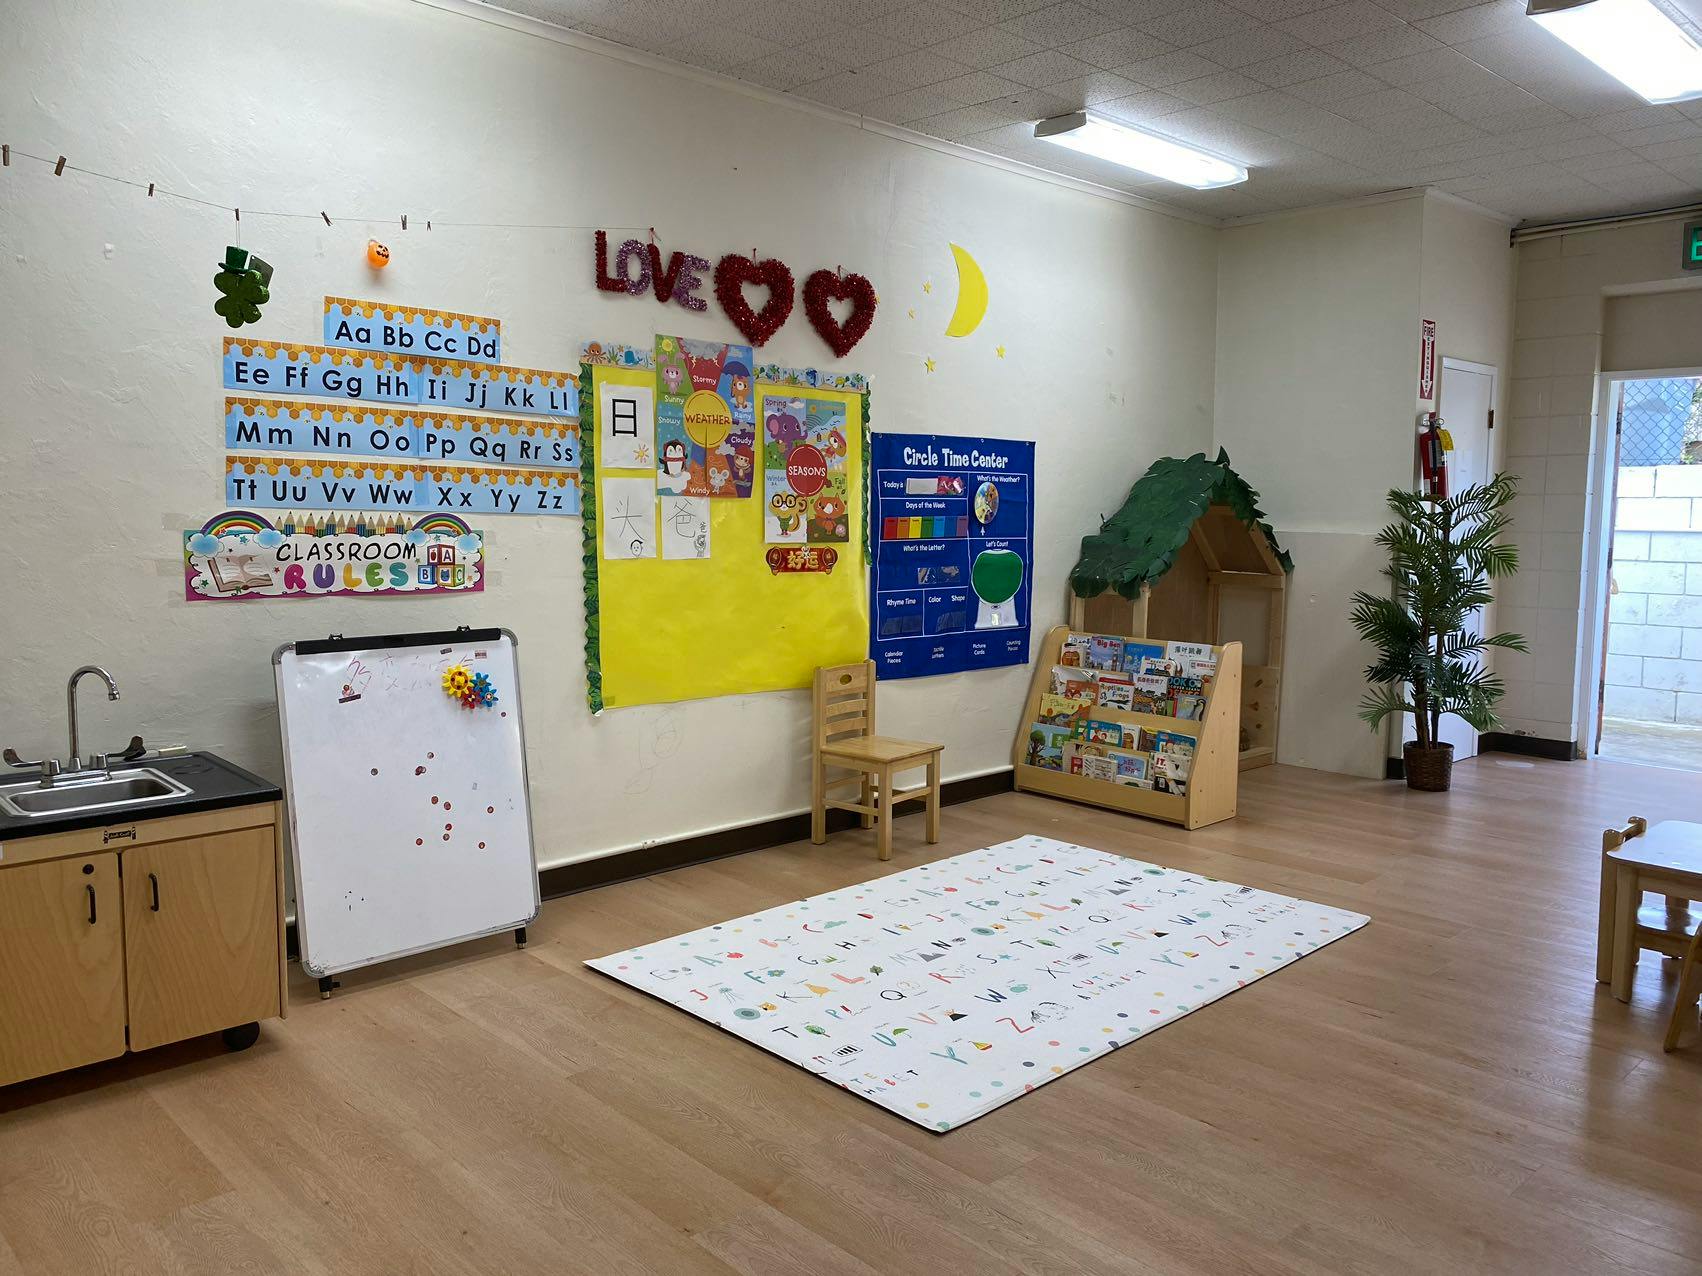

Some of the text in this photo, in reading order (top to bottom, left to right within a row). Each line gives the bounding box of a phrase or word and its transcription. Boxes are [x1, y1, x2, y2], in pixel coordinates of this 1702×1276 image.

[595, 230, 711, 311] LOVE
[1424, 325, 1434, 337] FIRE
[335, 321, 496, 359] Aa Bb Cc Dd
[235, 362, 568, 410] Ee Ff Gg Hh Ii Jj Kk Ll
[693, 375, 717, 386] Stormy
[665, 395, 684, 404] Sunny
[765, 398, 787, 409] Spring
[658, 417, 680, 425] Snowy
[685, 413, 731, 425] WEATHER
[734, 412, 752, 421] Rainy
[236, 421, 573, 462] Mm Nn Oo Pp Qq Rr Ss
[731, 436, 752, 446] Cloudy
[903, 446, 1008, 469] Circle Time Center
[788, 466, 826, 477] SEASONS
[766, 475, 787, 483] Winter
[835, 477, 845, 485] Fall
[884, 481, 899, 490] Today
[232, 479, 562, 512] Tt Uu Vv Ww Xx Yy Zz
[690, 487, 711, 496] Windy
[905, 501, 917, 509] Days
[611, 496, 644, 540] 头
[276, 543, 416, 561] CLASSROOM
[443, 551, 452, 562] A
[787, 551, 819, 569] 好运
[284, 562, 409, 590] RULES
[423, 570, 463, 581] B C
[887, 599, 904, 607] Rhyme
[1112, 691, 1129, 699] Frogs
[880, 989, 907, 1001] Q
[974, 988, 1007, 1003] W
[995, 1017, 1035, 1033] Z
[772, 1026, 799, 1038] T
